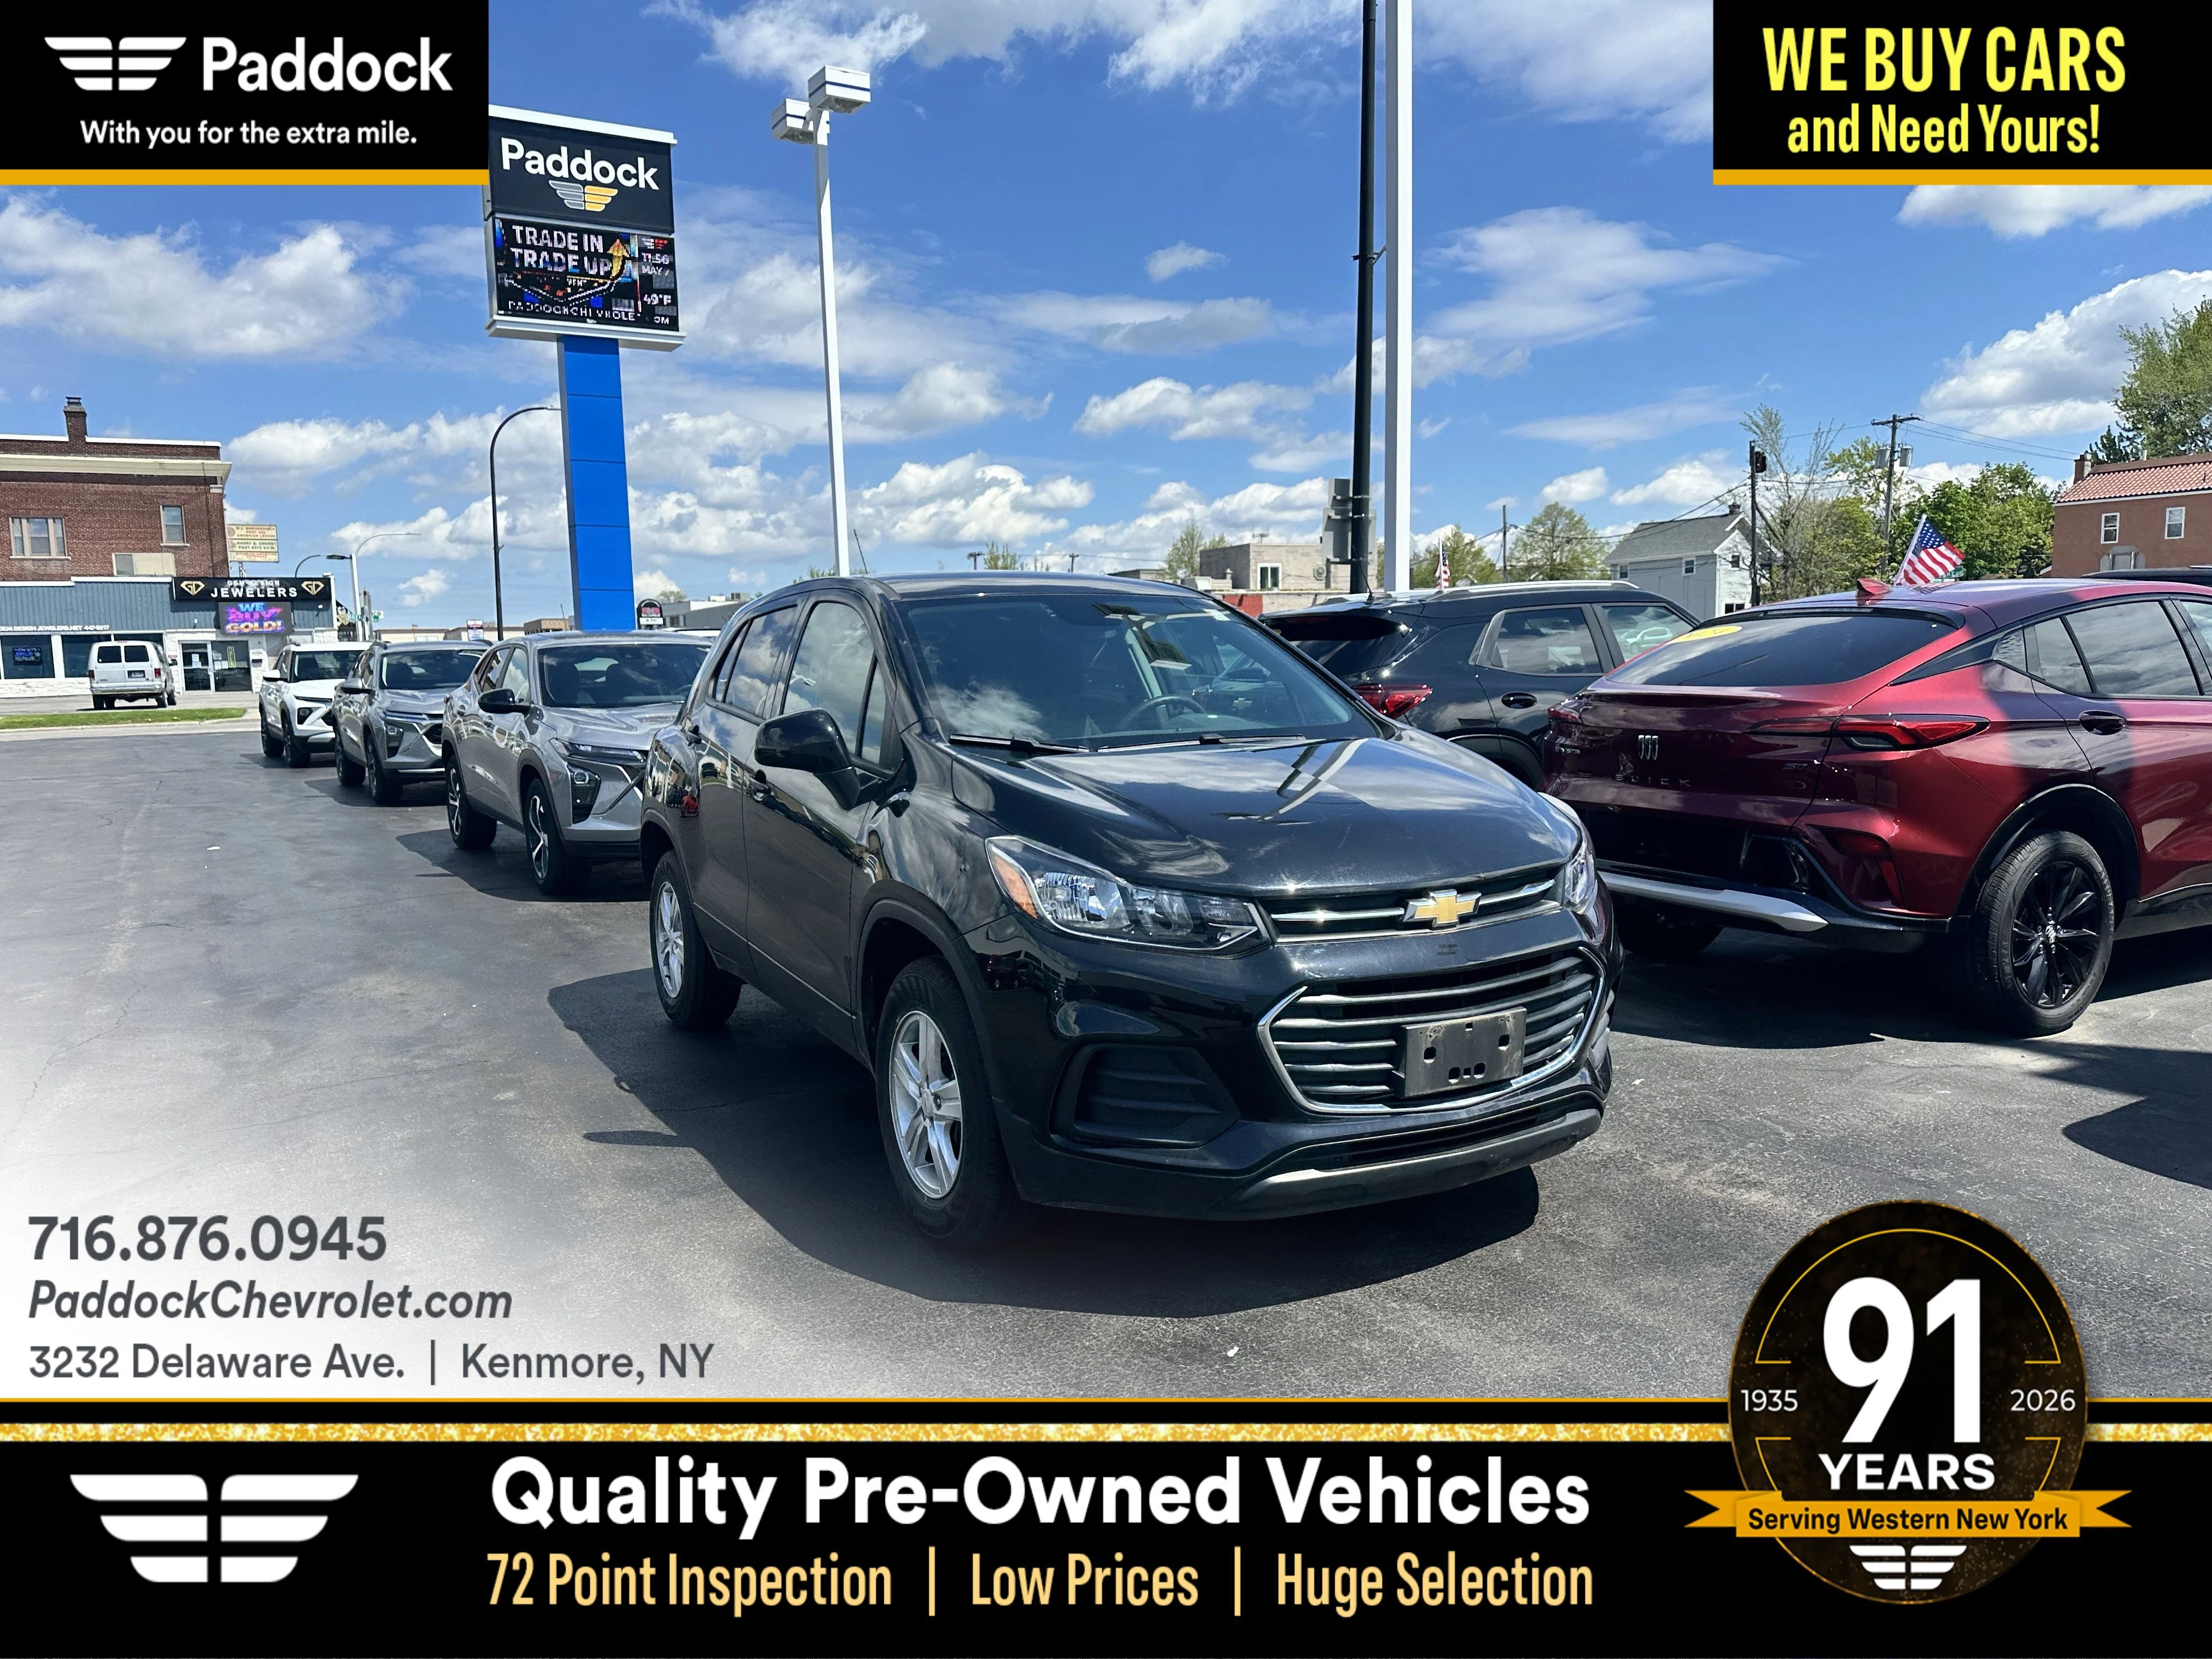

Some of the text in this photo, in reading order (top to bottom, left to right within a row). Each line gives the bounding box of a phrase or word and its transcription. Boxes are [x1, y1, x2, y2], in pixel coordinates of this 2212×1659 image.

[501, 137, 659, 190] Paddock
[512, 225, 603, 253] TRADE IN
[510, 248, 612, 276] TRADE UP
[211, 588, 298, 598] JEWELERS
[238, 602, 264, 612] WE
[228, 608, 281, 622] BUY
[225, 621, 282, 633] GOLD!
[1615, 774, 1690, 787] BUICK
